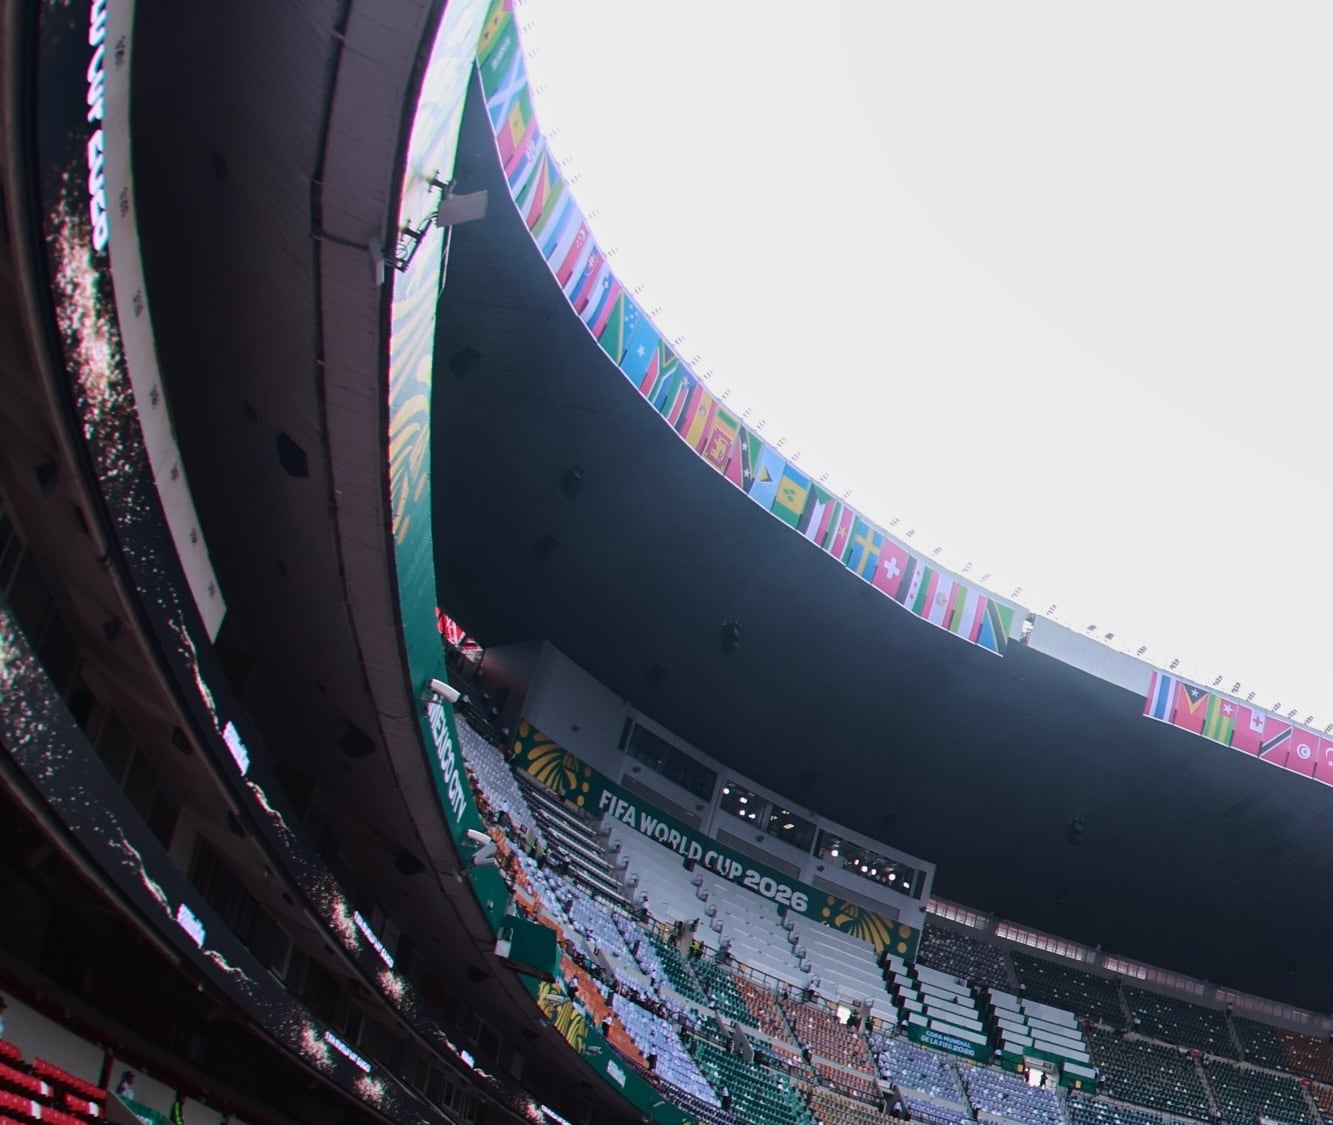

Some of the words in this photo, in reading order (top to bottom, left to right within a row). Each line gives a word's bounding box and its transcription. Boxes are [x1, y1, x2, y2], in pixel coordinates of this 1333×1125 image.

[448, 768, 467, 823] CITY
[598, 789, 636, 827] FIFA
[640, 811, 703, 860] WORLD
[705, 849, 743, 879] CUP
[743, 869, 809, 912] 2026
